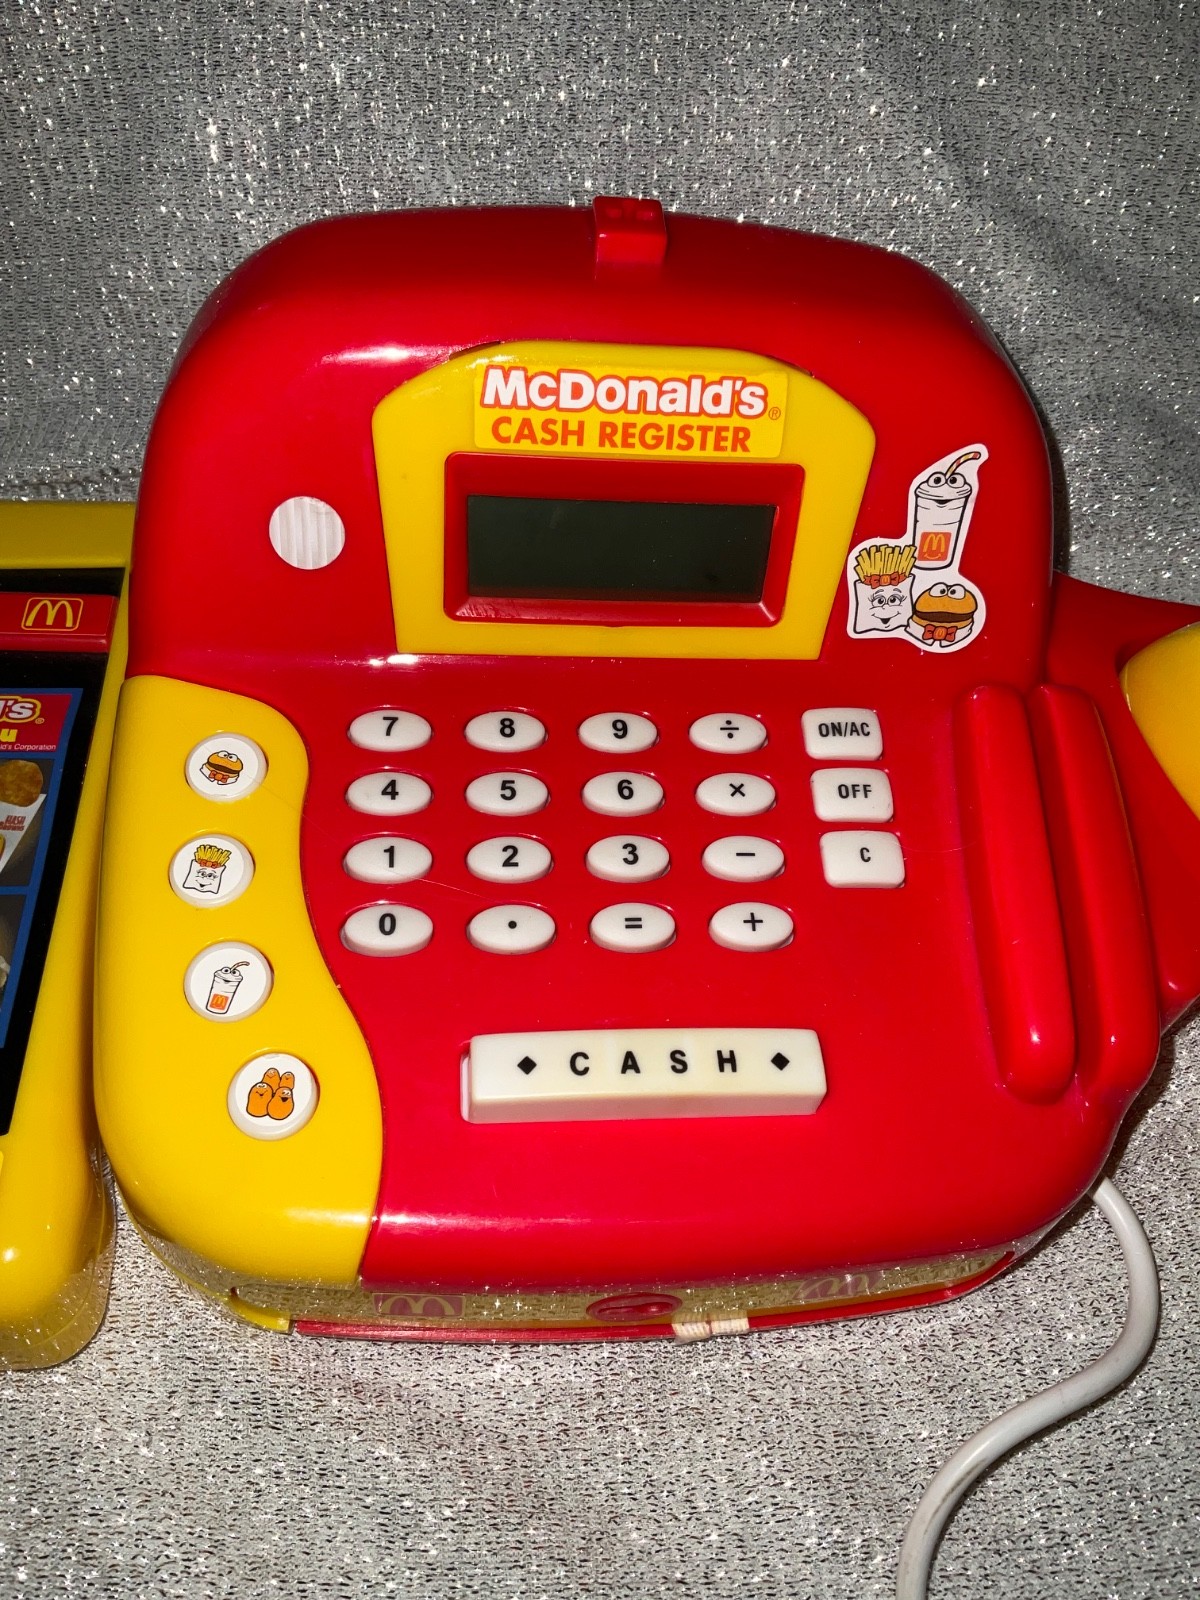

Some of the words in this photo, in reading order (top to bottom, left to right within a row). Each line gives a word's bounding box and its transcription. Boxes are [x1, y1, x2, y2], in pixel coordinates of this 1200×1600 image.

[491, 416, 585, 447] CASH
[598, 421, 751, 453] REGISTER
[382, 716, 399, 737] 7
[499, 717, 516, 738] 8
[611, 719, 629, 740] 9
[818, 720, 871, 738] ON/AC
[14, 743, 57, 751] Corporation
[381, 779, 399, 800] 4
[500, 779, 517, 801] 5
[617, 779, 634, 801] 6
[837, 782, 873, 800] OFF
[382, 845, 396, 868] 1
[501, 844, 519, 868] 2
[622, 842, 639, 866] 3
[859, 846, 871, 864] C
